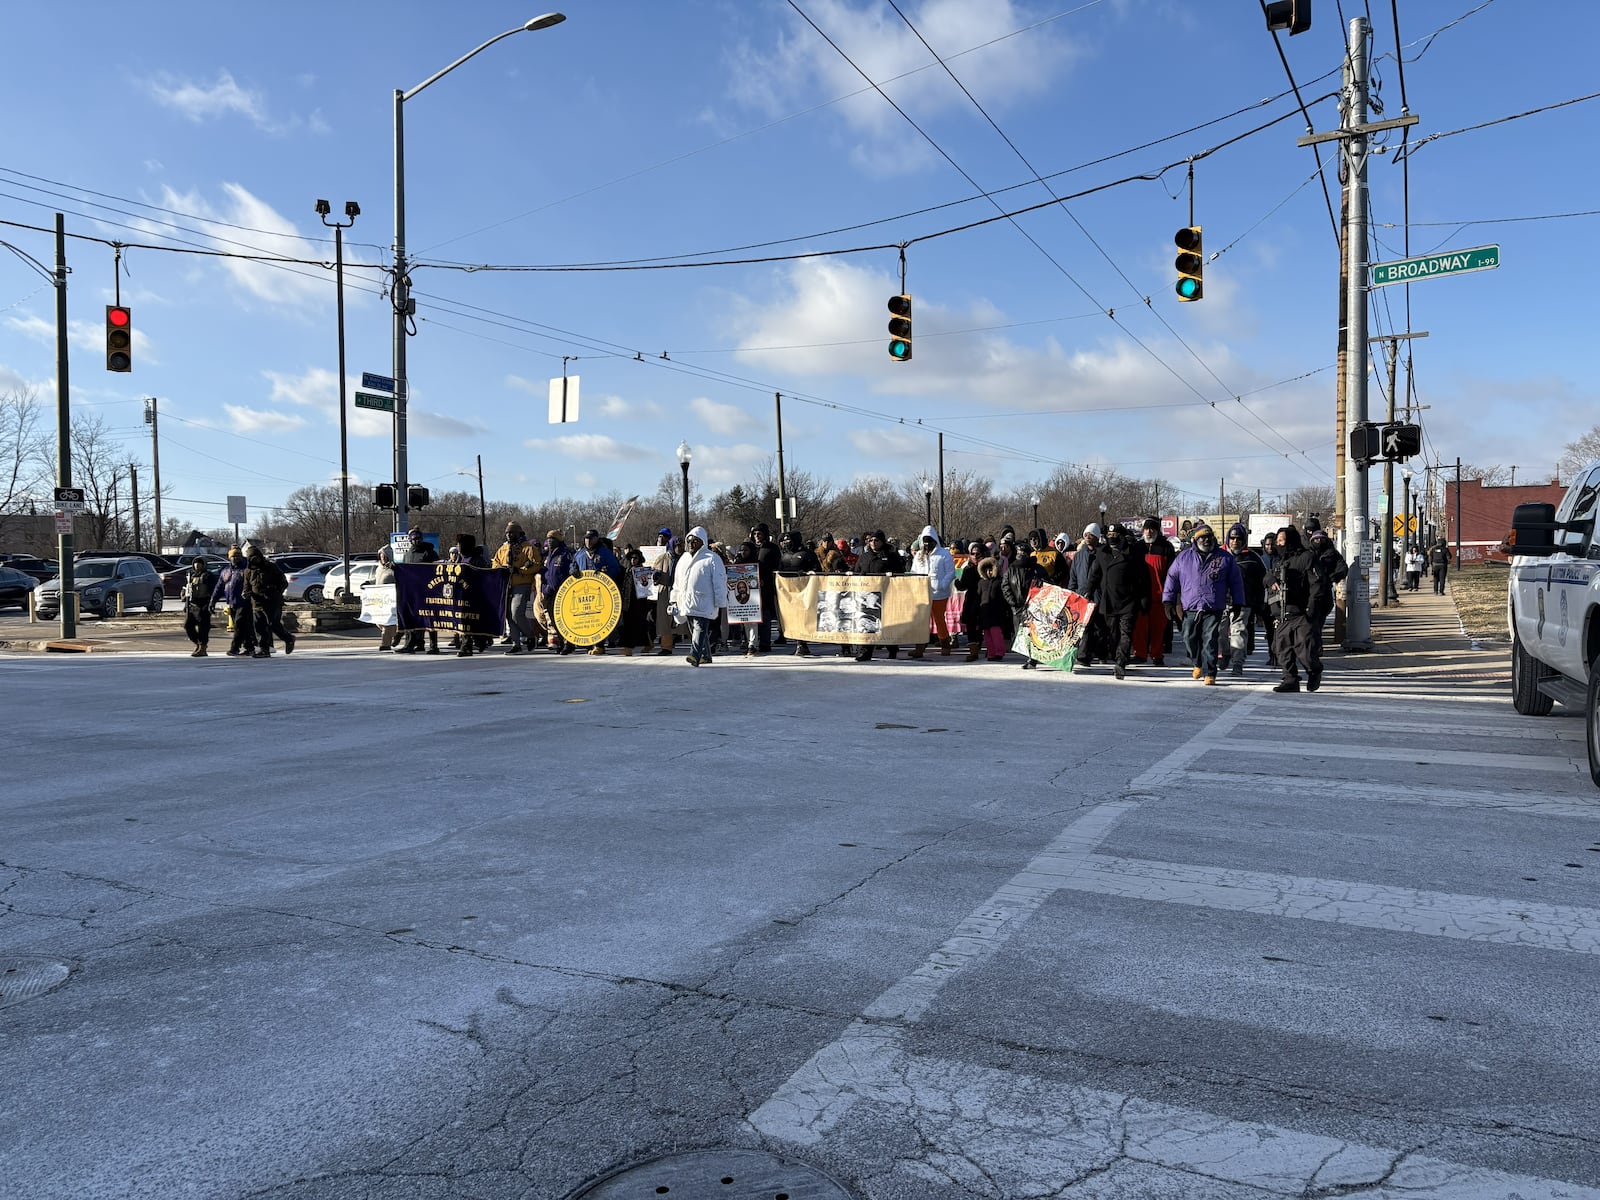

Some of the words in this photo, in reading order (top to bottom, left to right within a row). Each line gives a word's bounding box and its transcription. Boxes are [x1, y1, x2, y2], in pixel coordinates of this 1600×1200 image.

[1378, 271, 1385, 279] N
[1388, 254, 1471, 280] BROADWAY
[1477, 257, 1495, 267] 1-99
[363, 396, 384, 408] THIRD
[555, 587, 567, 615] ASSOCIATION
[578, 595, 595, 604] NAACP
[612, 592, 620, 616] COLORED
[454, 611, 480, 620] CHAPTER
[606, 615, 618, 632] PEOPLE
